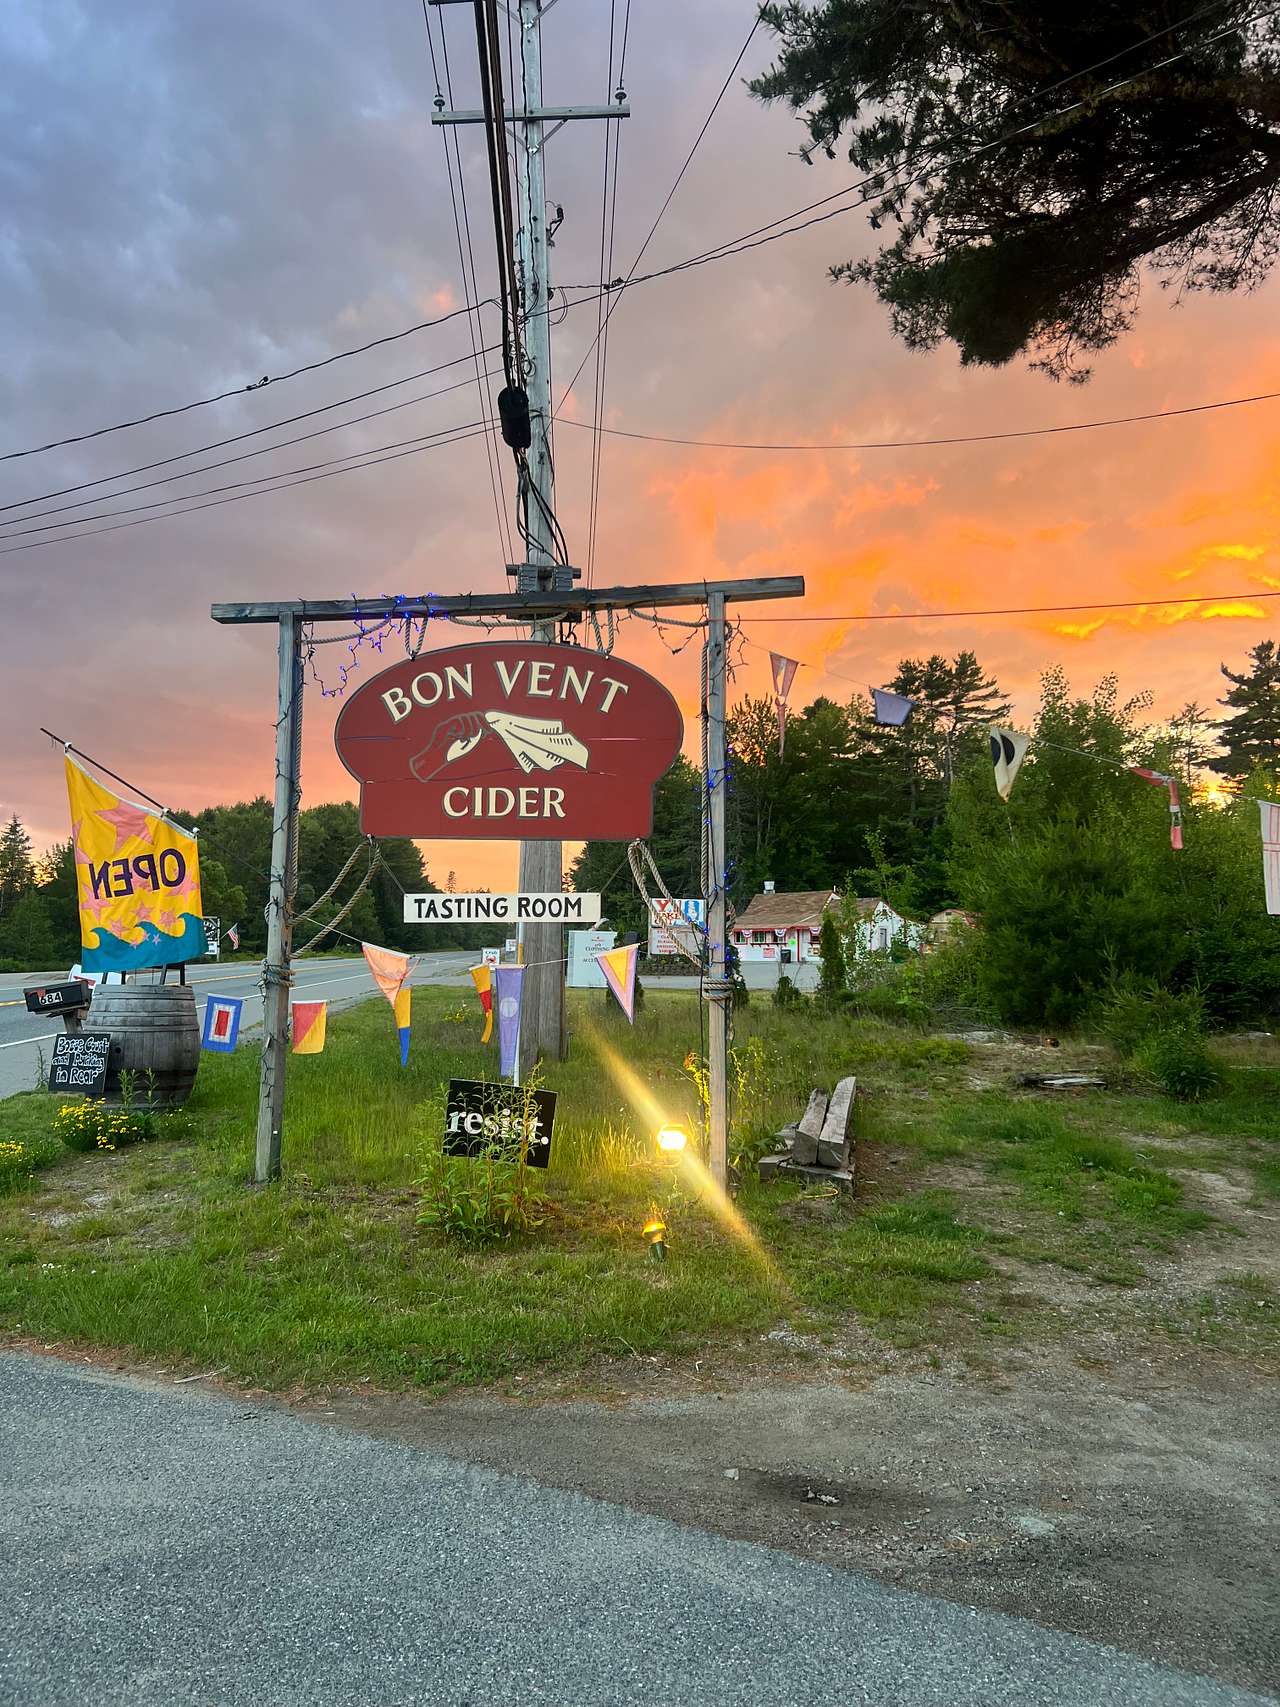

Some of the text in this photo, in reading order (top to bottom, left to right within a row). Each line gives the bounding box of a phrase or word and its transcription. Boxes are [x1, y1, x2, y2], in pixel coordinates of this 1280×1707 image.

[381, 660, 629, 722] BON VENT
[443, 786, 566, 818] CIDER
[414, 897, 582, 919] TASTING ROOM
[40, 992, 61, 1004] 684
[52, 1053, 70, 1065] and
[56, 1067, 98, 1084] in Rear
